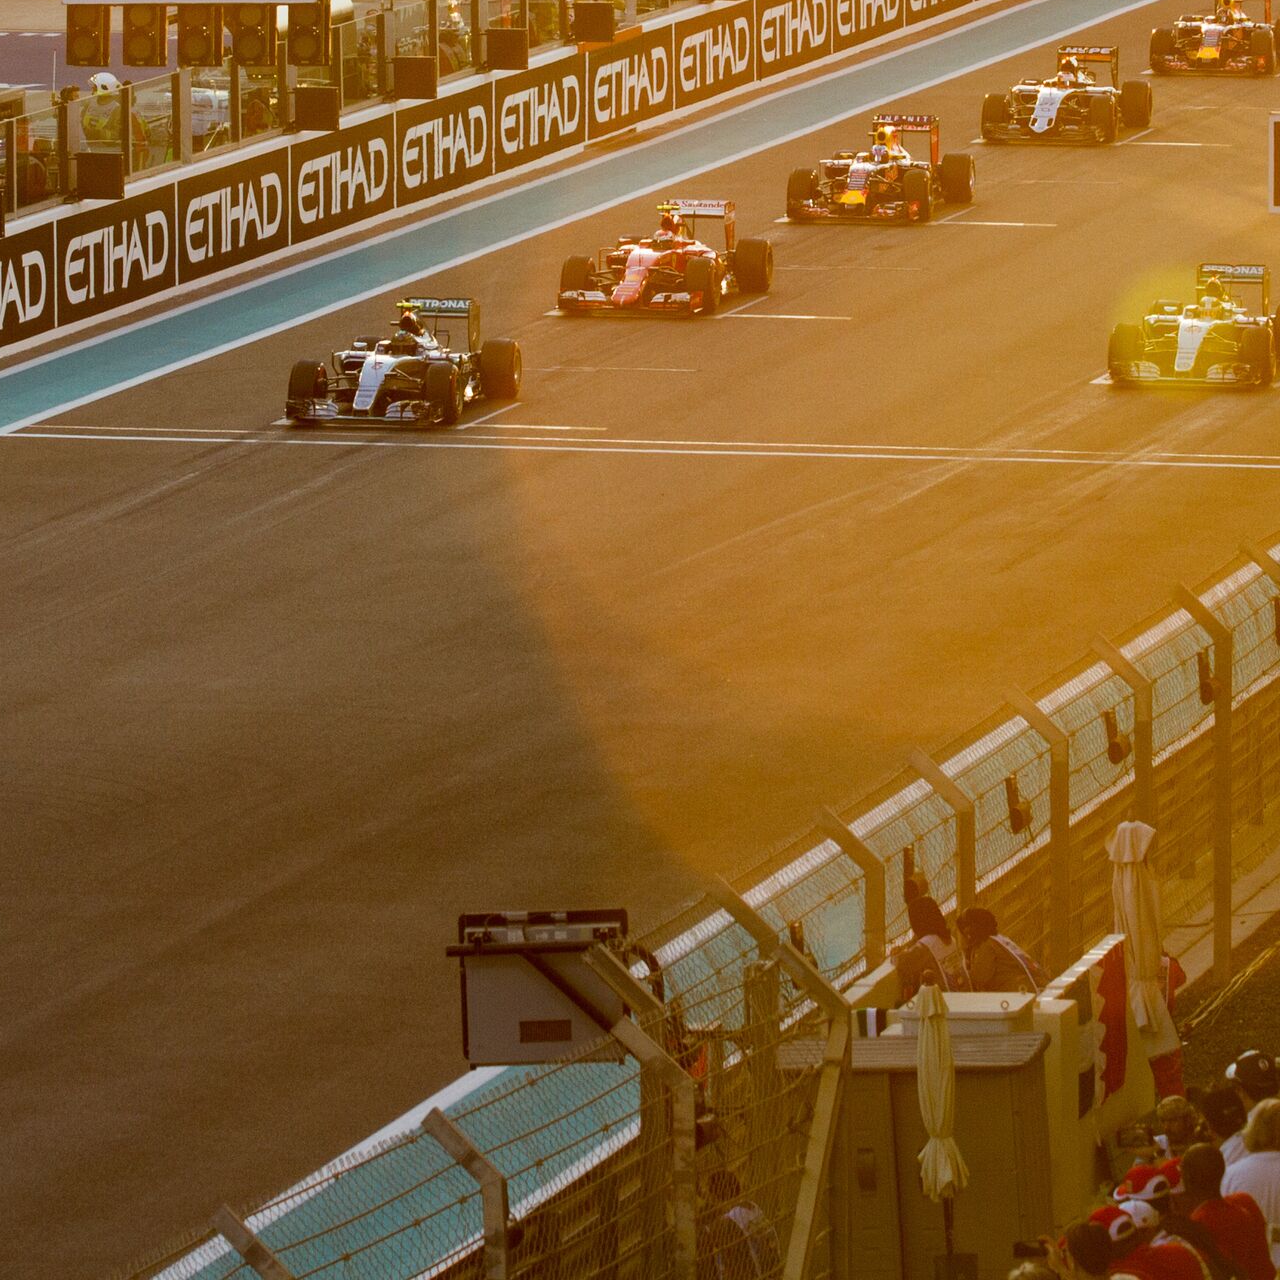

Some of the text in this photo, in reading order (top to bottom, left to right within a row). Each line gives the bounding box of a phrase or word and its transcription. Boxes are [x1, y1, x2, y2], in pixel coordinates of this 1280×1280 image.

[593, 46, 669, 123] ETIHAD
[679, 16, 750, 92] ETIHAD
[402, 104, 488, 189] ETIHAD
[500, 74, 581, 154] ETIHAD
[185, 172, 283, 263] ETIHAD
[297, 137, 389, 225] ETIHAD
[64, 209, 169, 305] ETIHAD
